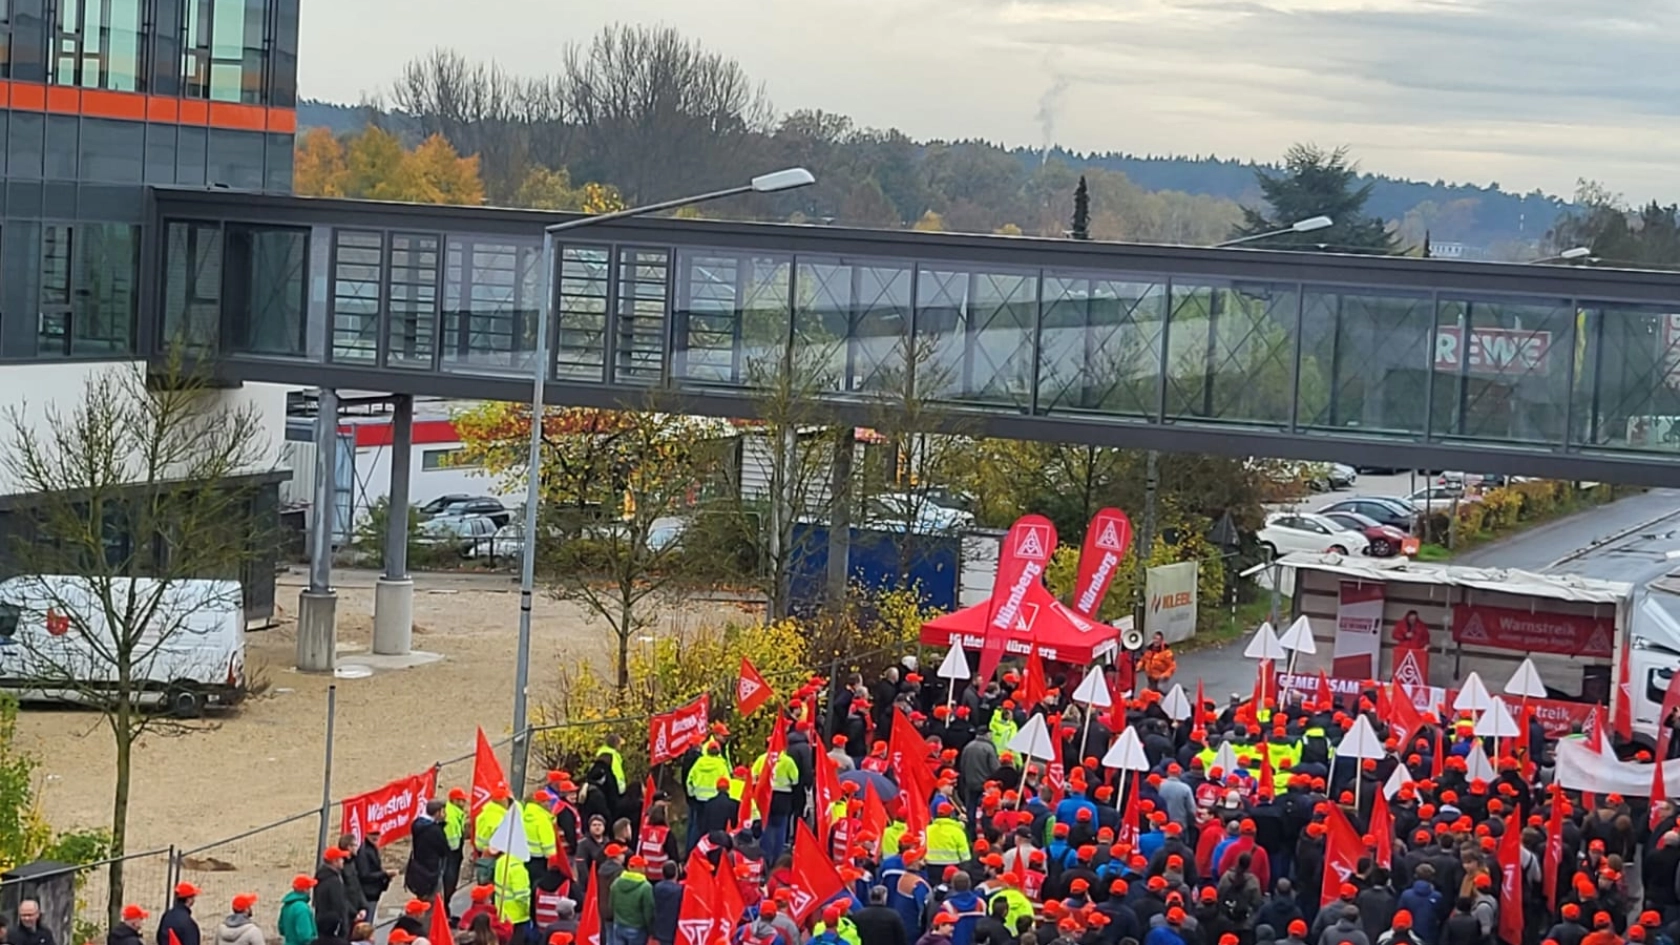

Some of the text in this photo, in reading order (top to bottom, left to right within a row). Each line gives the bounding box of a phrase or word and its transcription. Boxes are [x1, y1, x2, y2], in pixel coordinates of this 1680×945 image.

[1436, 333, 1541, 369] REWE
[992, 560, 1041, 630] Nürnberg
[1078, 551, 1117, 614] Nürnberg
[1501, 617, 1576, 636] Warnstreik
[1278, 674, 1360, 694] GEMEISAM
